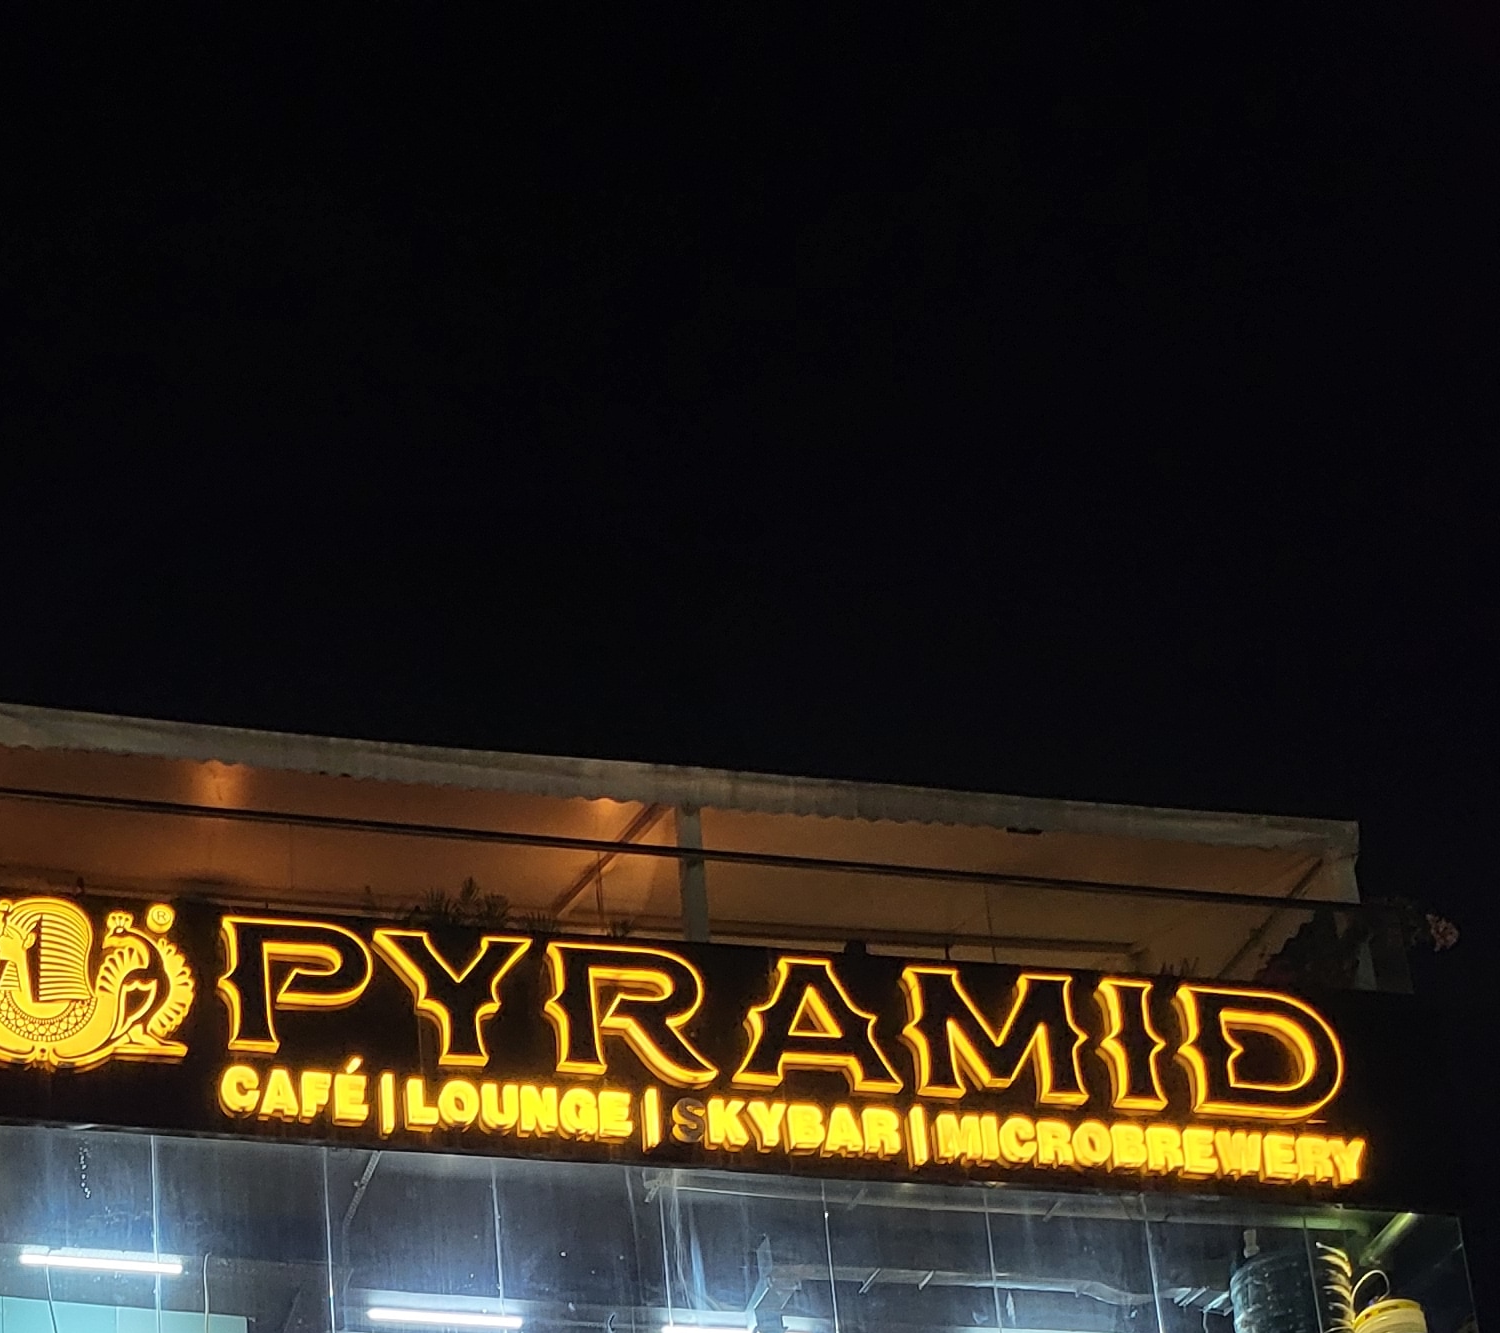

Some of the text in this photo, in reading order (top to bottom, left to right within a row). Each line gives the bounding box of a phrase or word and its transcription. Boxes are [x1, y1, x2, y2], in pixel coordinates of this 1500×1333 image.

[217, 914, 1344, 1121] PYRAMID
[218, 1056, 1366, 1186] CAFÉ LOUNGE SKYBAR MICROBREWERY
